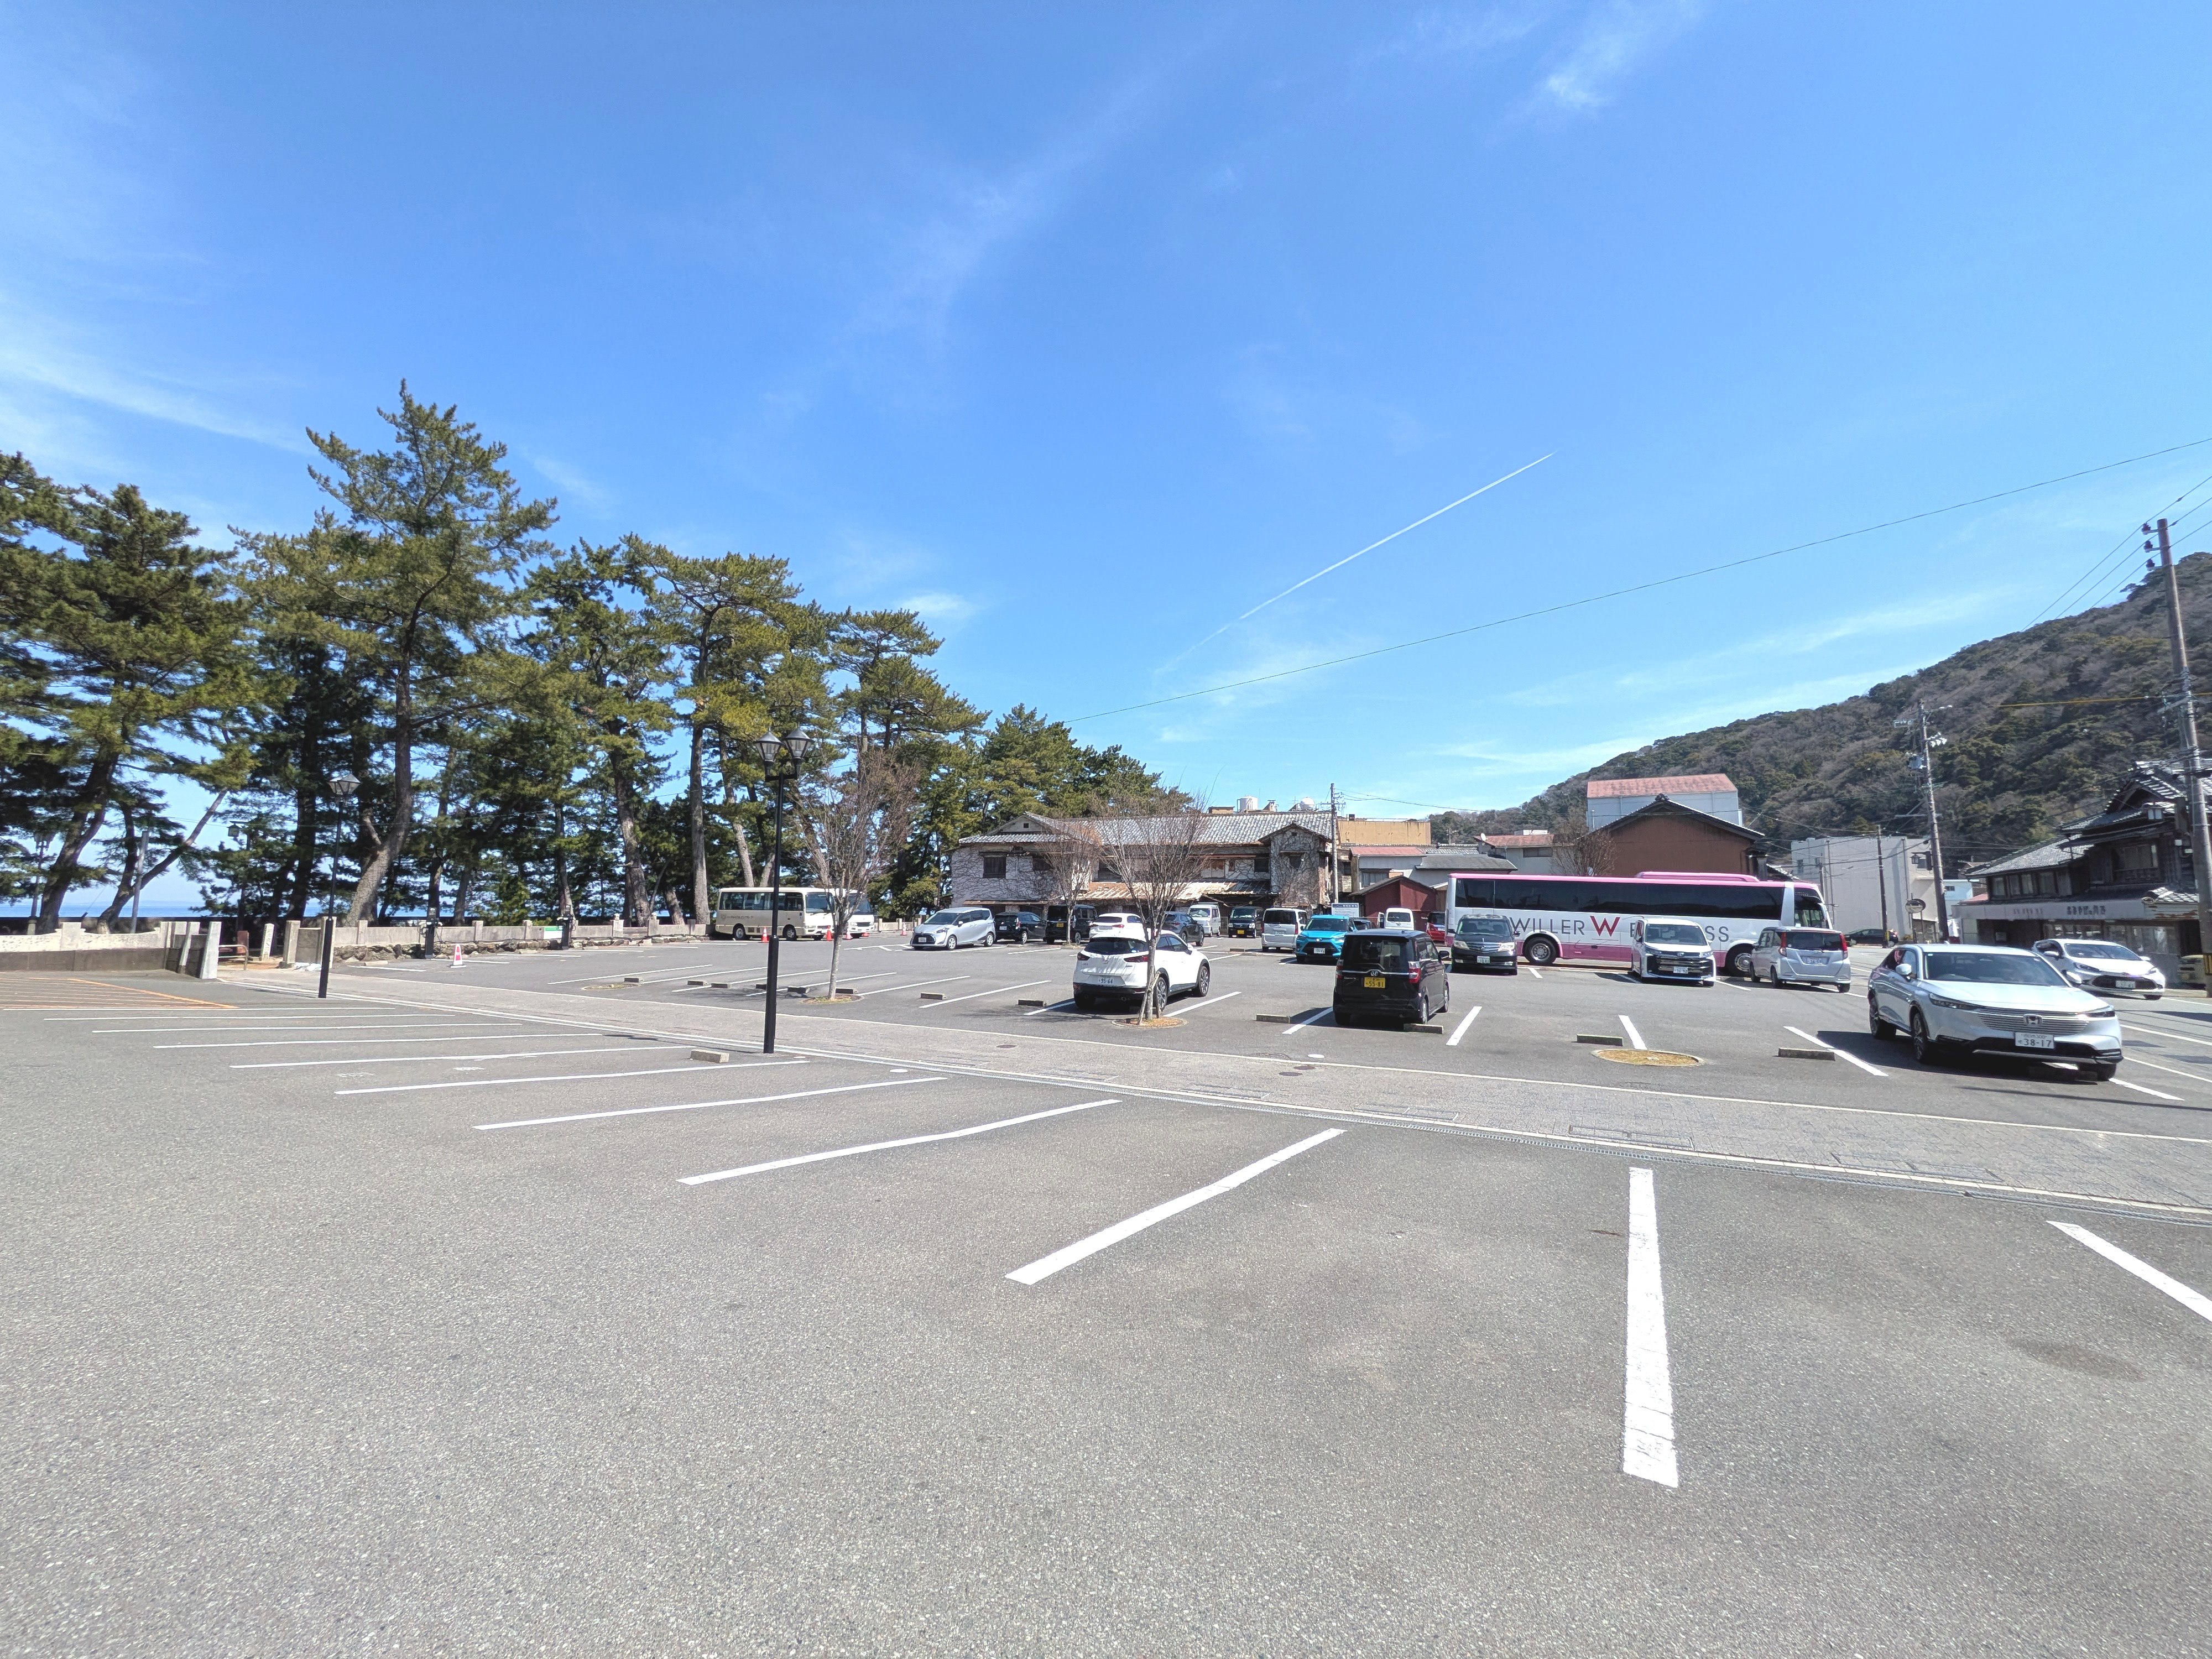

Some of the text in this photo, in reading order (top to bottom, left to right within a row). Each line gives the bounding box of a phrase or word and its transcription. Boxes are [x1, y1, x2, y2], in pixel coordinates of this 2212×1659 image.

[1509, 917, 1585, 935] WILLER
[1590, 916, 1620, 937] W
[2024, 1038, 2052, 1047] 38-17
